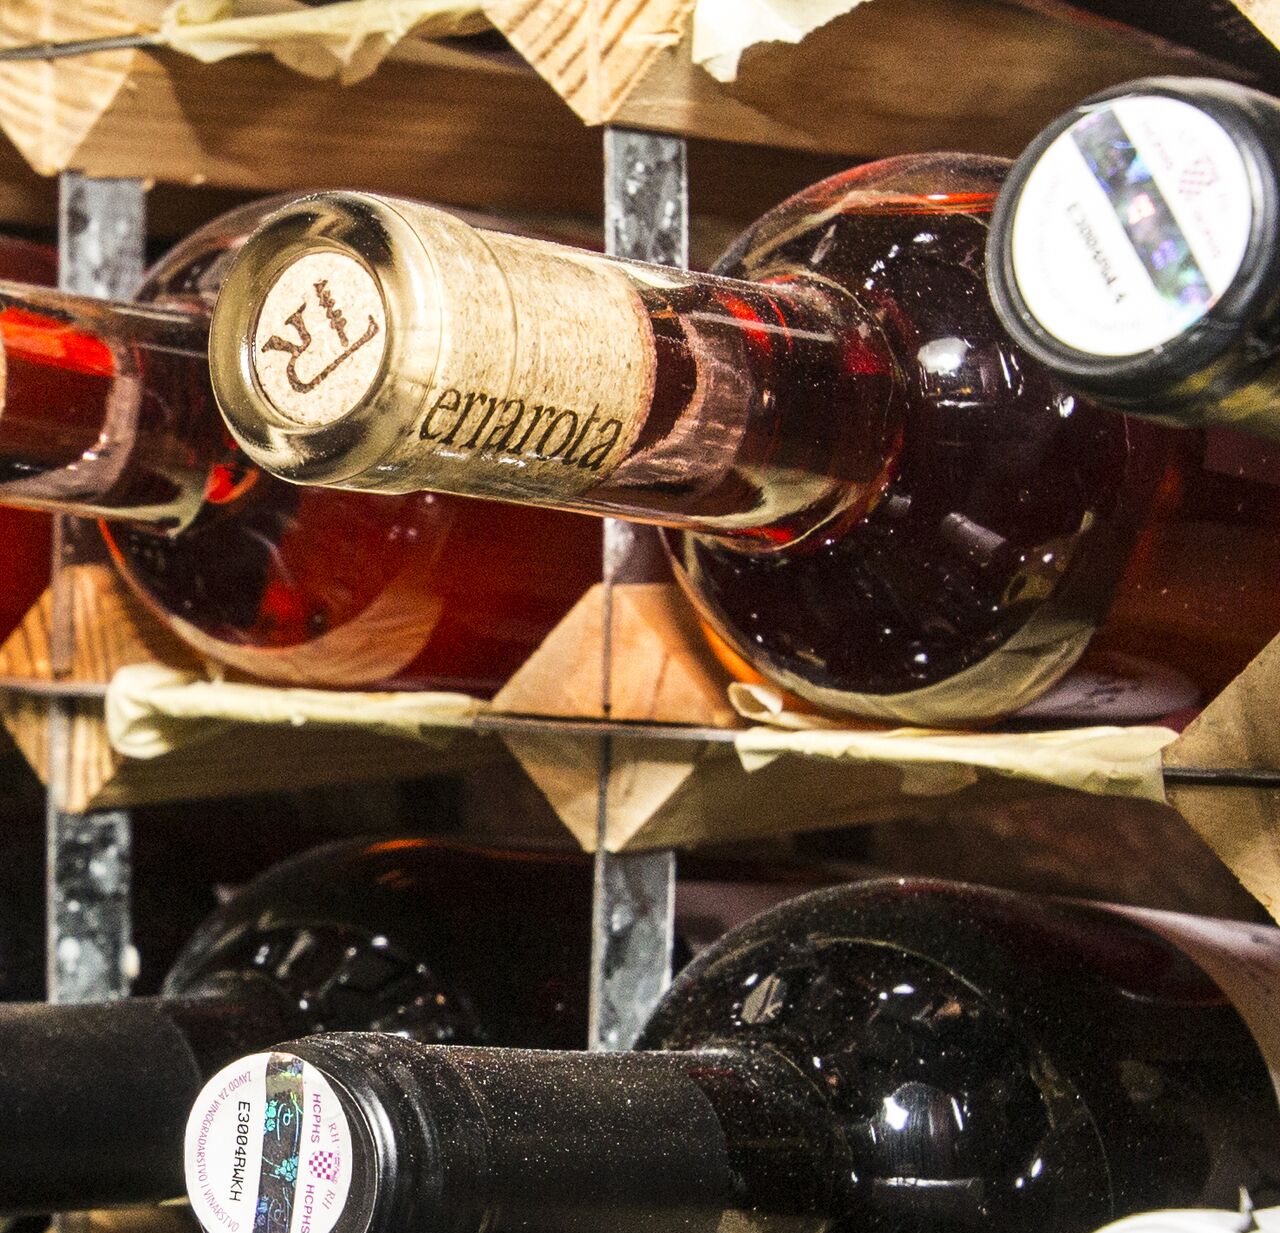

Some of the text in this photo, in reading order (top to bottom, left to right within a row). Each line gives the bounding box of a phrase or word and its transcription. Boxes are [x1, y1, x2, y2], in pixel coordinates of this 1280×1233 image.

[419, 387, 623, 472] errarota
[229, 1101, 250, 1202] E3004RWKH
[310, 1093, 321, 1143] HCPHS
